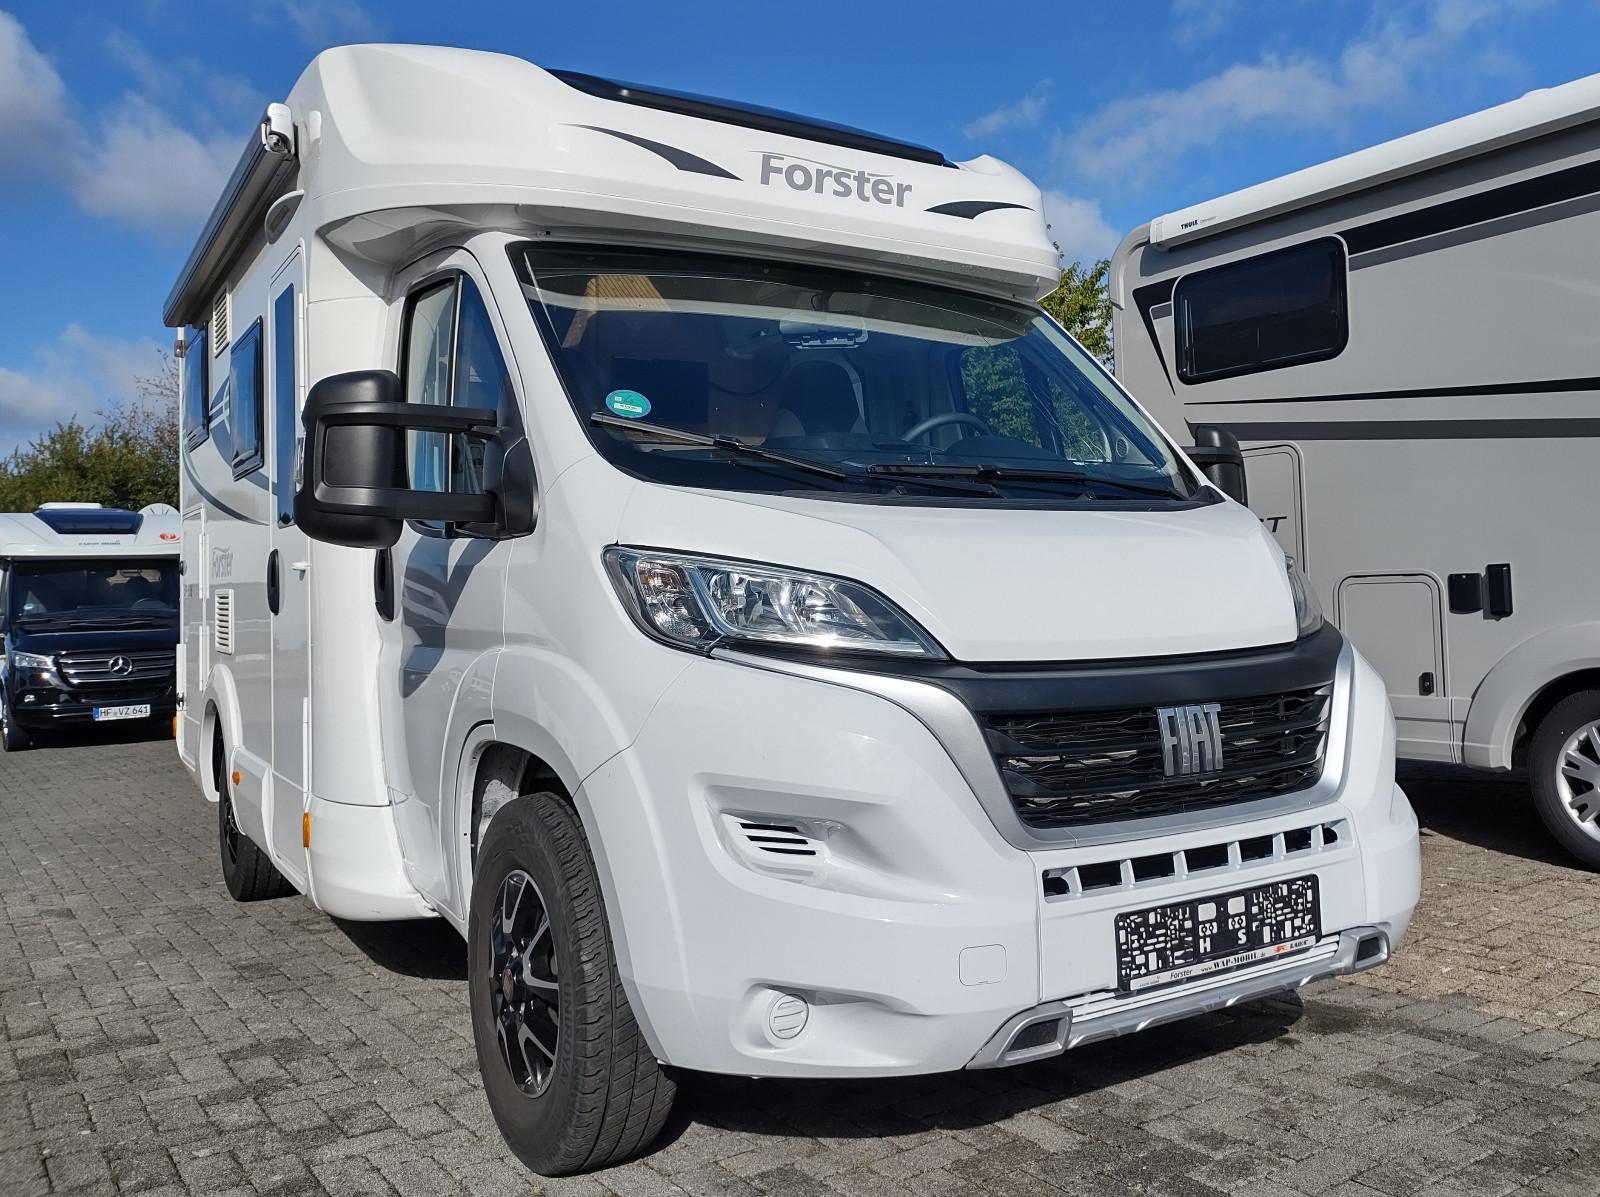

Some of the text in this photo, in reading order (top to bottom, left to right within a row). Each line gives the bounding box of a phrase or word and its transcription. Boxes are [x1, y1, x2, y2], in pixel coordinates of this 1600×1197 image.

[760, 153, 913, 208] Forster
[1180, 219, 1198, 230] THULE
[211, 551, 233, 578] Forster
[101, 705, 149, 717] HF VZ 641
[1157, 703, 1223, 776] FIAT
[1170, 968, 1192, 979] Forster
[559, 981, 575, 1088] UNIROYAL
